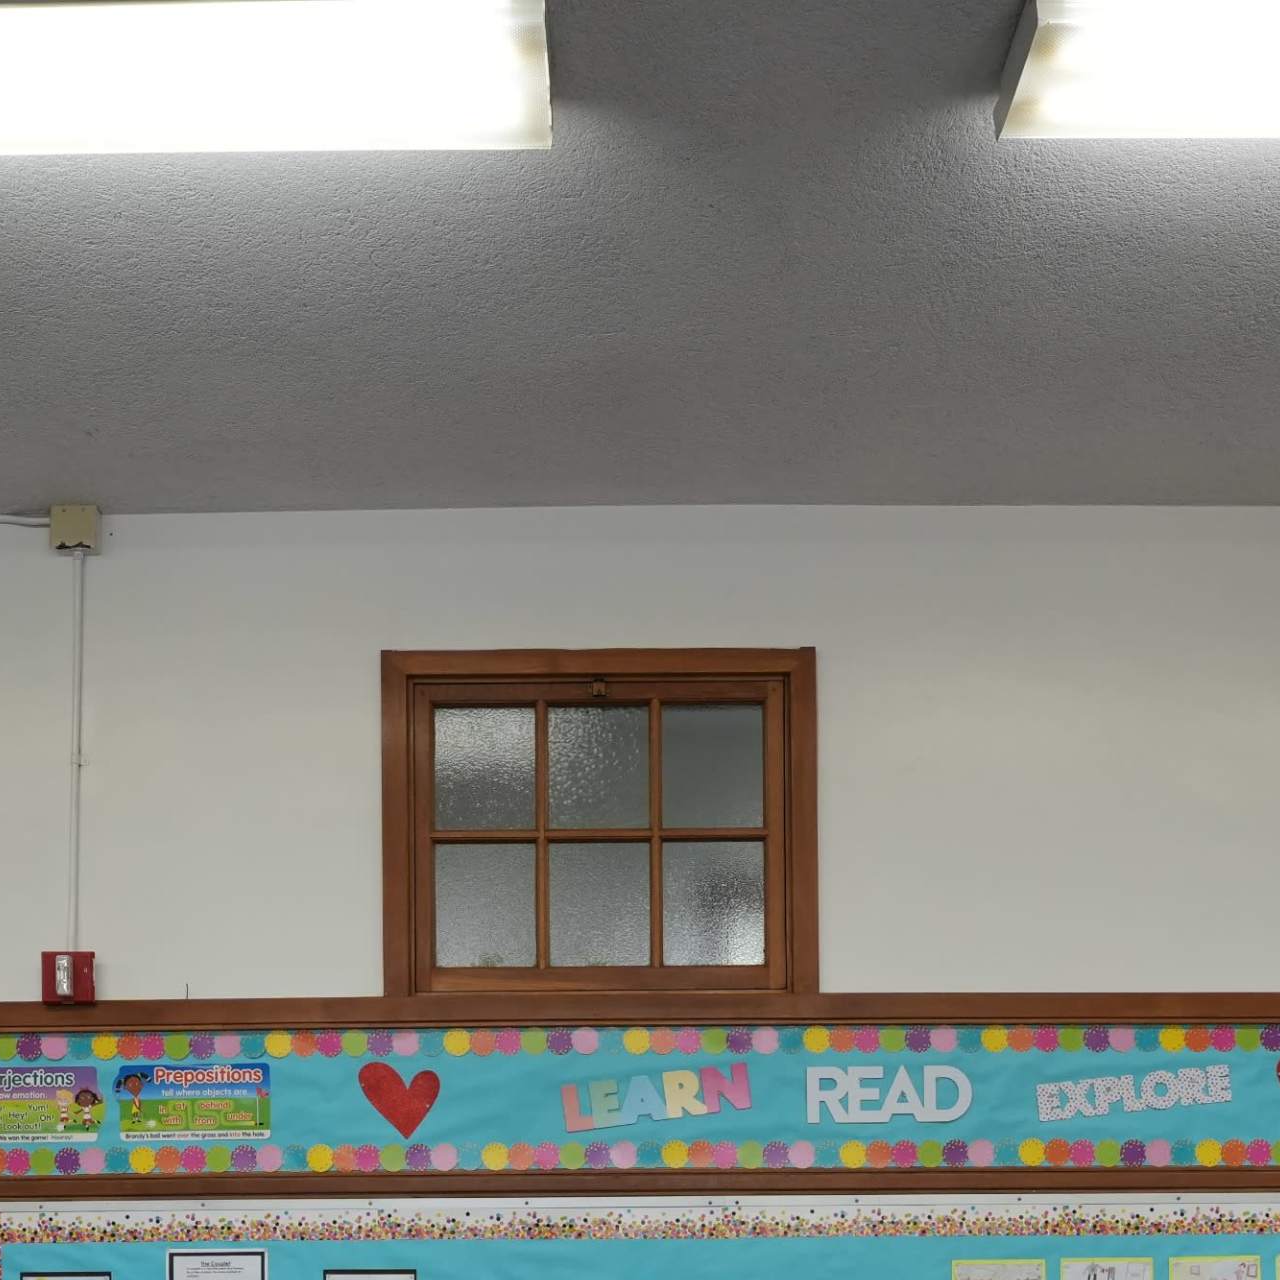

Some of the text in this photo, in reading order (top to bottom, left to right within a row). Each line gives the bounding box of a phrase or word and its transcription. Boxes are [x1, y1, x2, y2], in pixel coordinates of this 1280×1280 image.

[154, 1066, 263, 1087] Prepositions
[175, 1089, 200, 1097] where
[202, 1088, 232, 1098] objects
[561, 1062, 753, 1133] LEARN
[806, 1064, 973, 1124] READ
[1036, 1064, 1232, 1122] EXPLORE
